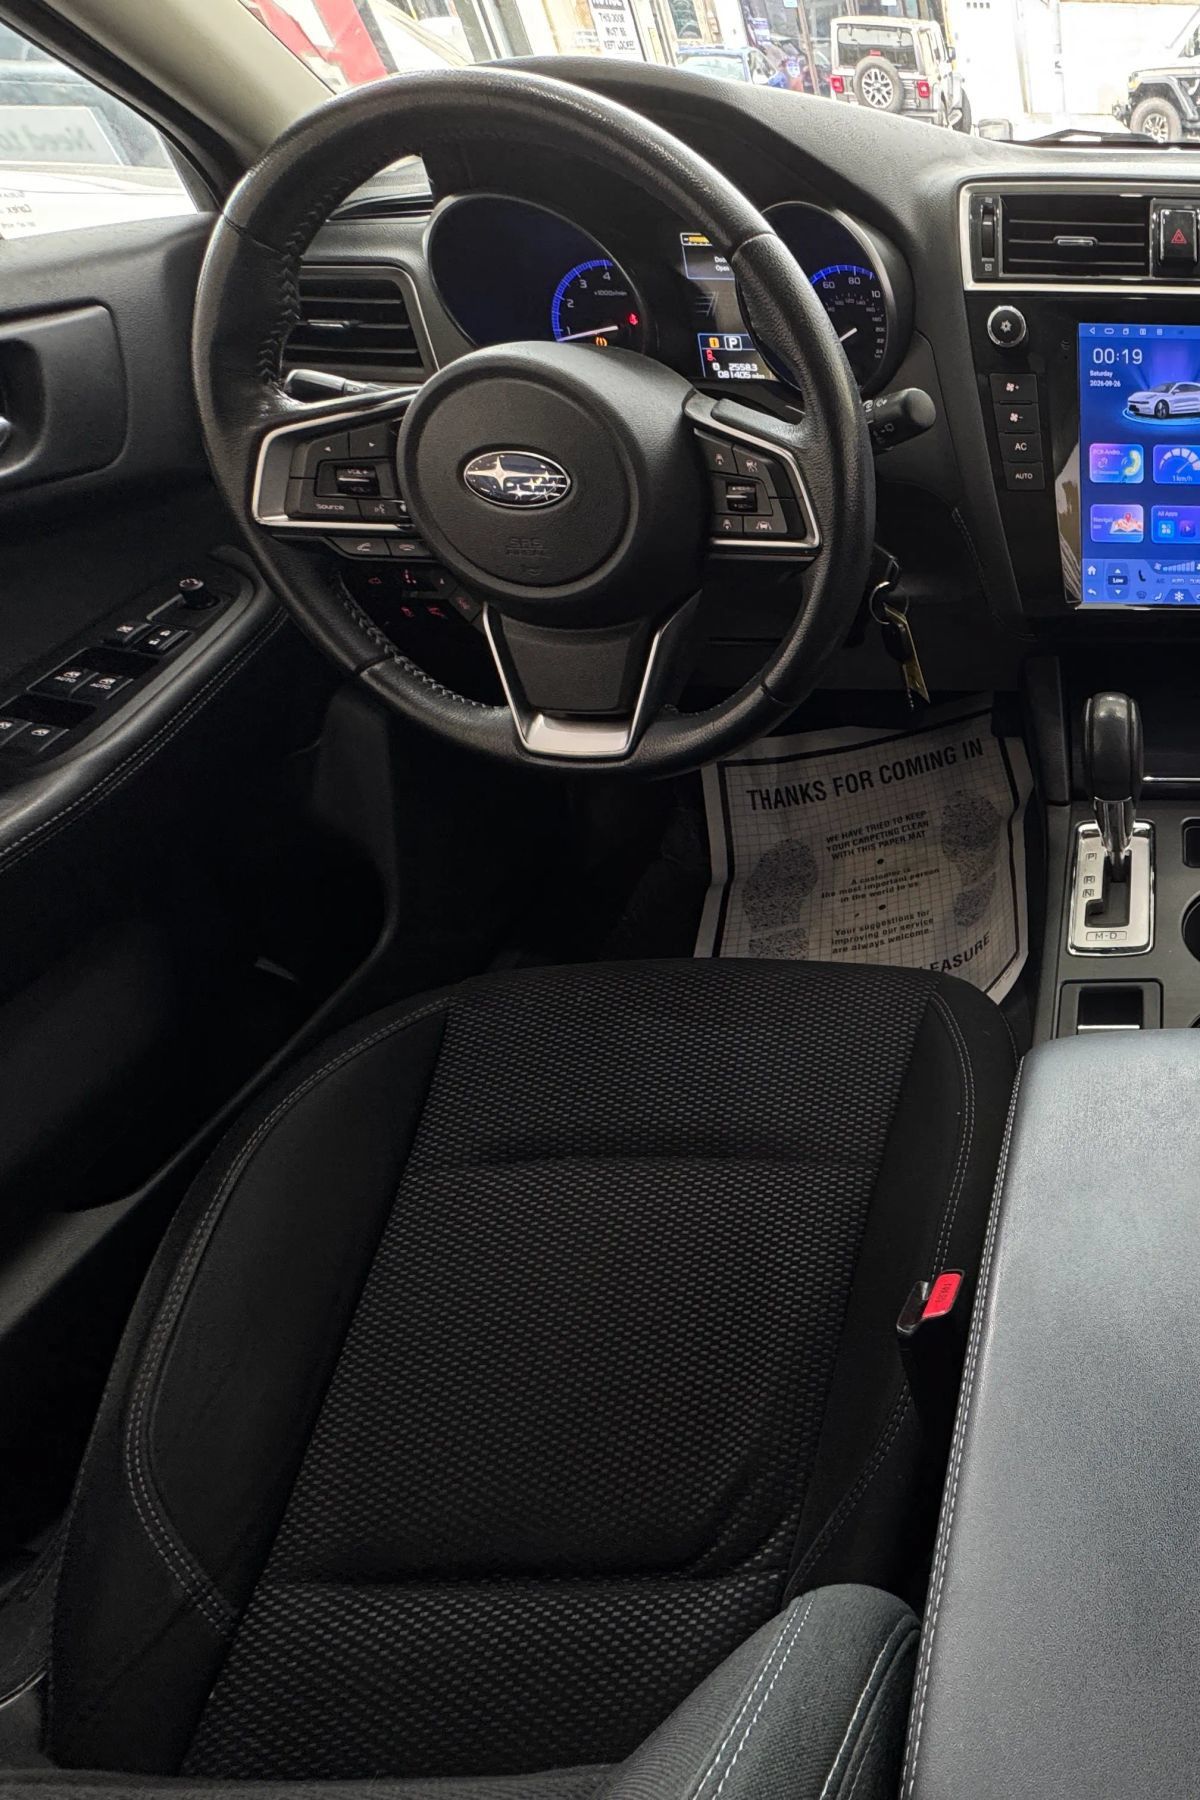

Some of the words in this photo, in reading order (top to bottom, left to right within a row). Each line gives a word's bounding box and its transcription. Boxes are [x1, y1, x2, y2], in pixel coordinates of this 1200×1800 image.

[603, 272, 611, 281] 4
[848, 277, 861, 285] 80
[580, 279, 588, 288] 3
[823, 281, 836, 289] 60
[872, 290, 881, 298] 10
[567, 299, 575, 308] 2
[729, 337, 738, 349] P
[1093, 347, 1143, 365] 00:19
[1090, 370, 1113, 378] Saturday
[1014, 442, 1028, 451] AC
[316, 503, 345, 511] Source
[746, 780, 827, 810] THANKS
[832, 770, 874, 797] FOR
[878, 746, 958, 785] COMING
[962, 738, 984, 760] IN
[842, 828, 863, 840] HAVE
[865, 820, 890, 832] TRIED
[892, 816, 904, 824] TO
[905, 810, 927, 821] KEEP
[826, 842, 850, 852] YOUR
[852, 826, 900, 846] CARPETING
[902, 820, 929, 832] CLEAN
[831, 850, 854, 860] WITH
[858, 842, 876, 853] THIS
[878, 836, 906, 848] PAPER
[908, 830, 926, 840] MAT
[840, 884, 861, 894] most
[864, 876, 906, 890] important
[910, 868, 940, 880] person
[860, 871, 901, 883] customer
[852, 892, 866, 900] the
[870, 886, 894, 898] world
[835, 927, 856, 936] Your
[860, 914, 914, 932] suggestions
[917, 910, 930, 918] for
[832, 931, 880, 945] improving
[882, 926, 897, 936] our
[900, 918, 934, 930] service
[832, 946, 848, 954] are
[852, 939, 886, 952] always
